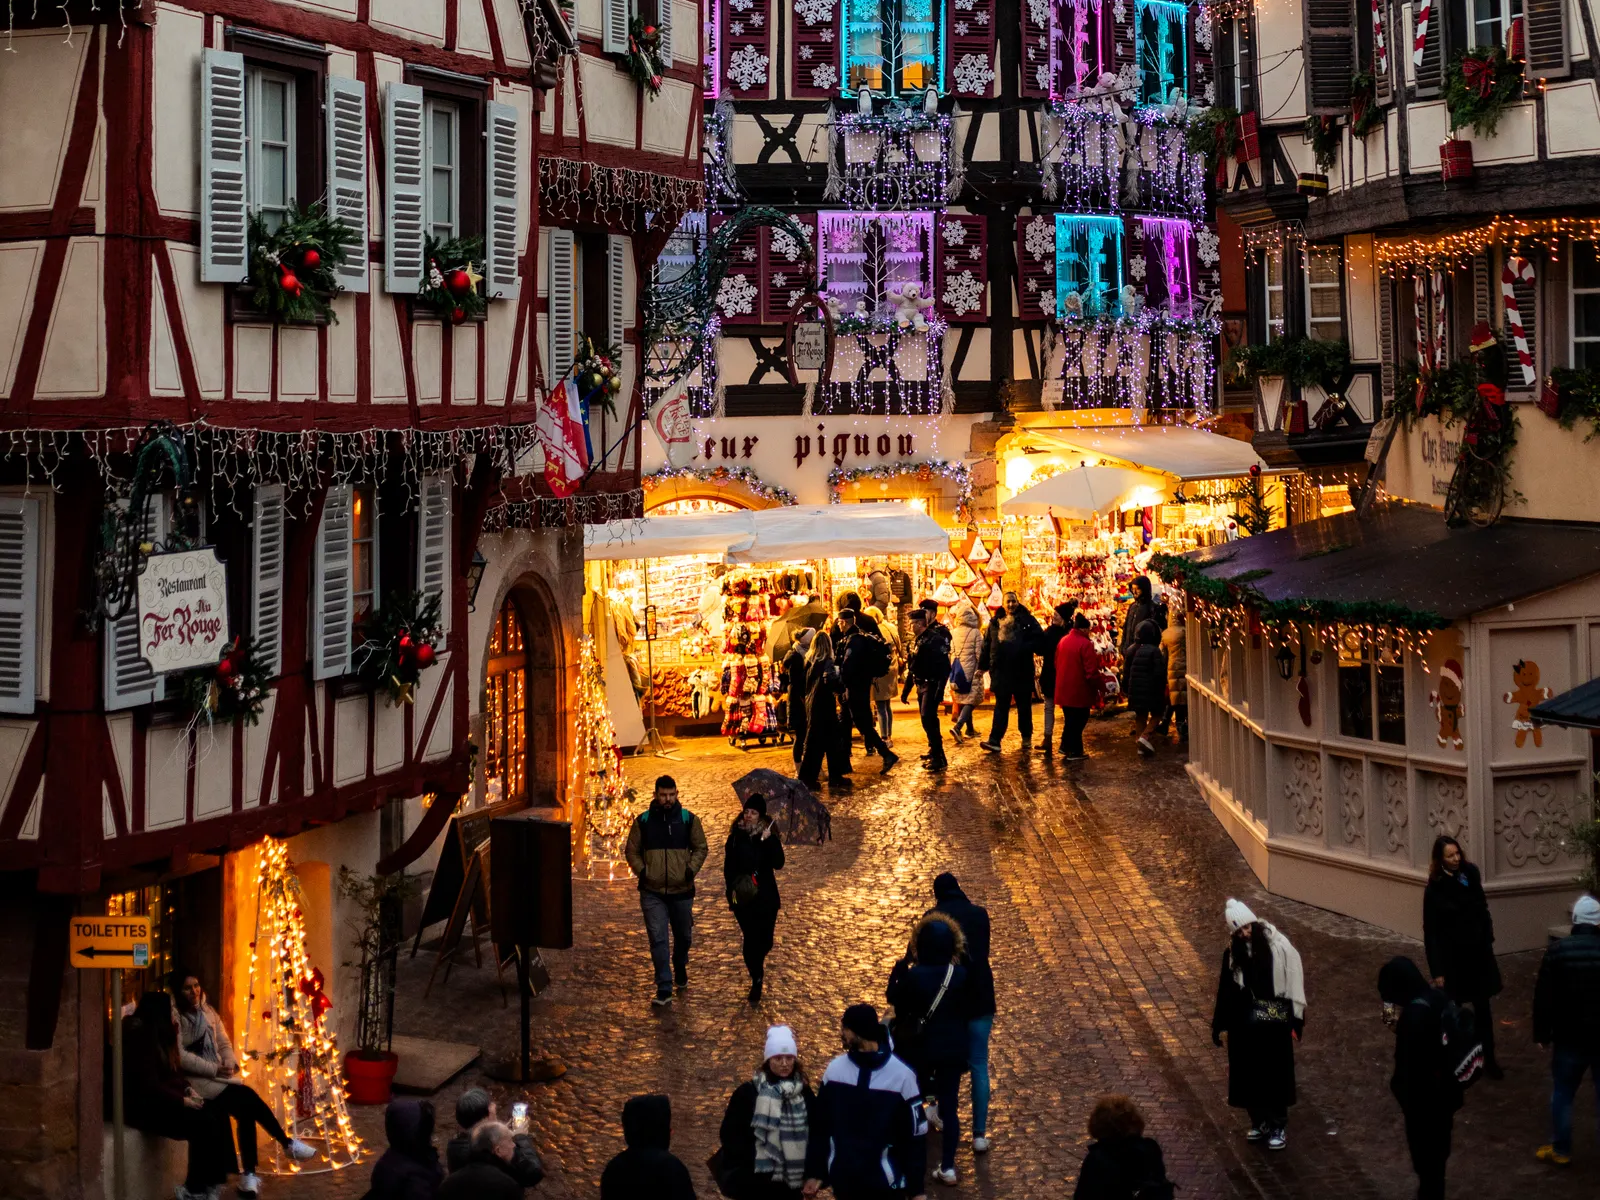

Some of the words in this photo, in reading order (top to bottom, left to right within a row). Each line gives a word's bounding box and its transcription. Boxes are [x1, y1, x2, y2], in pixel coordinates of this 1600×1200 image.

[793, 423, 915, 470] pignon
[157, 574, 207, 598] Restaurant
[195, 596, 211, 614] Au
[143, 612, 175, 657] Fer
[172, 604, 221, 647] Rouge
[73, 923, 147, 938] TOILETTES
